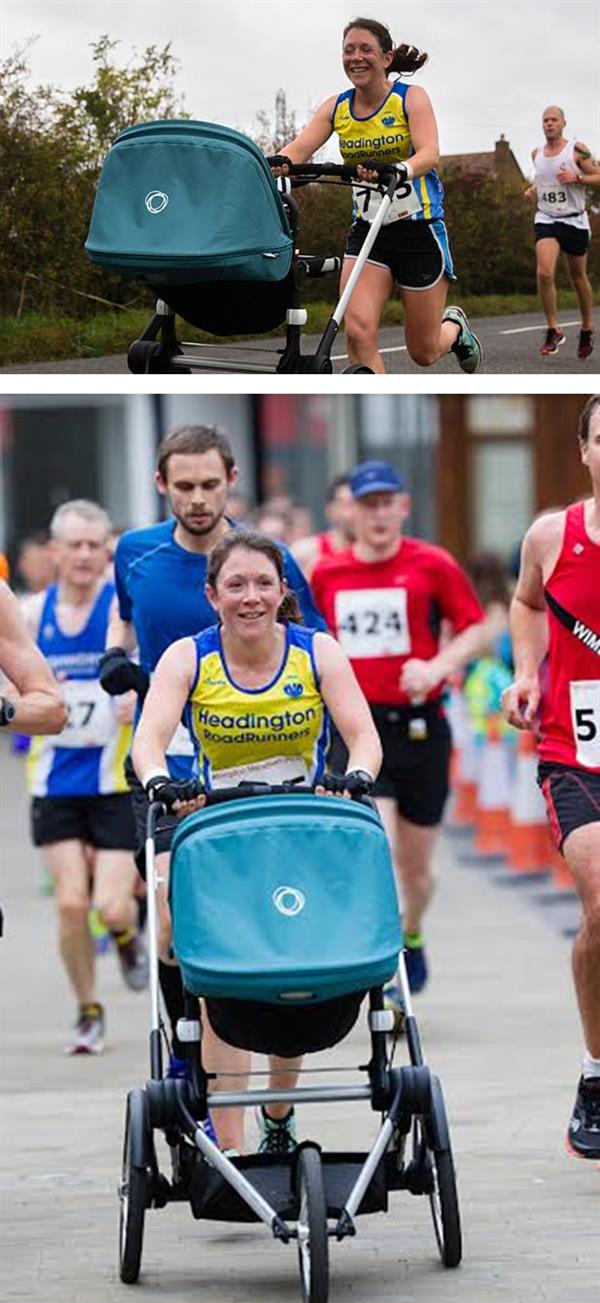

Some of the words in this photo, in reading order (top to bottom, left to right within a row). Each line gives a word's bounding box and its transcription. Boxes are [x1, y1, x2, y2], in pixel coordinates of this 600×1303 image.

[341, 133, 404, 150] eadington
[340, 611, 401, 635] 424
[198, 706, 316, 732] Headington
[203, 727, 311, 744] RoadRunners
